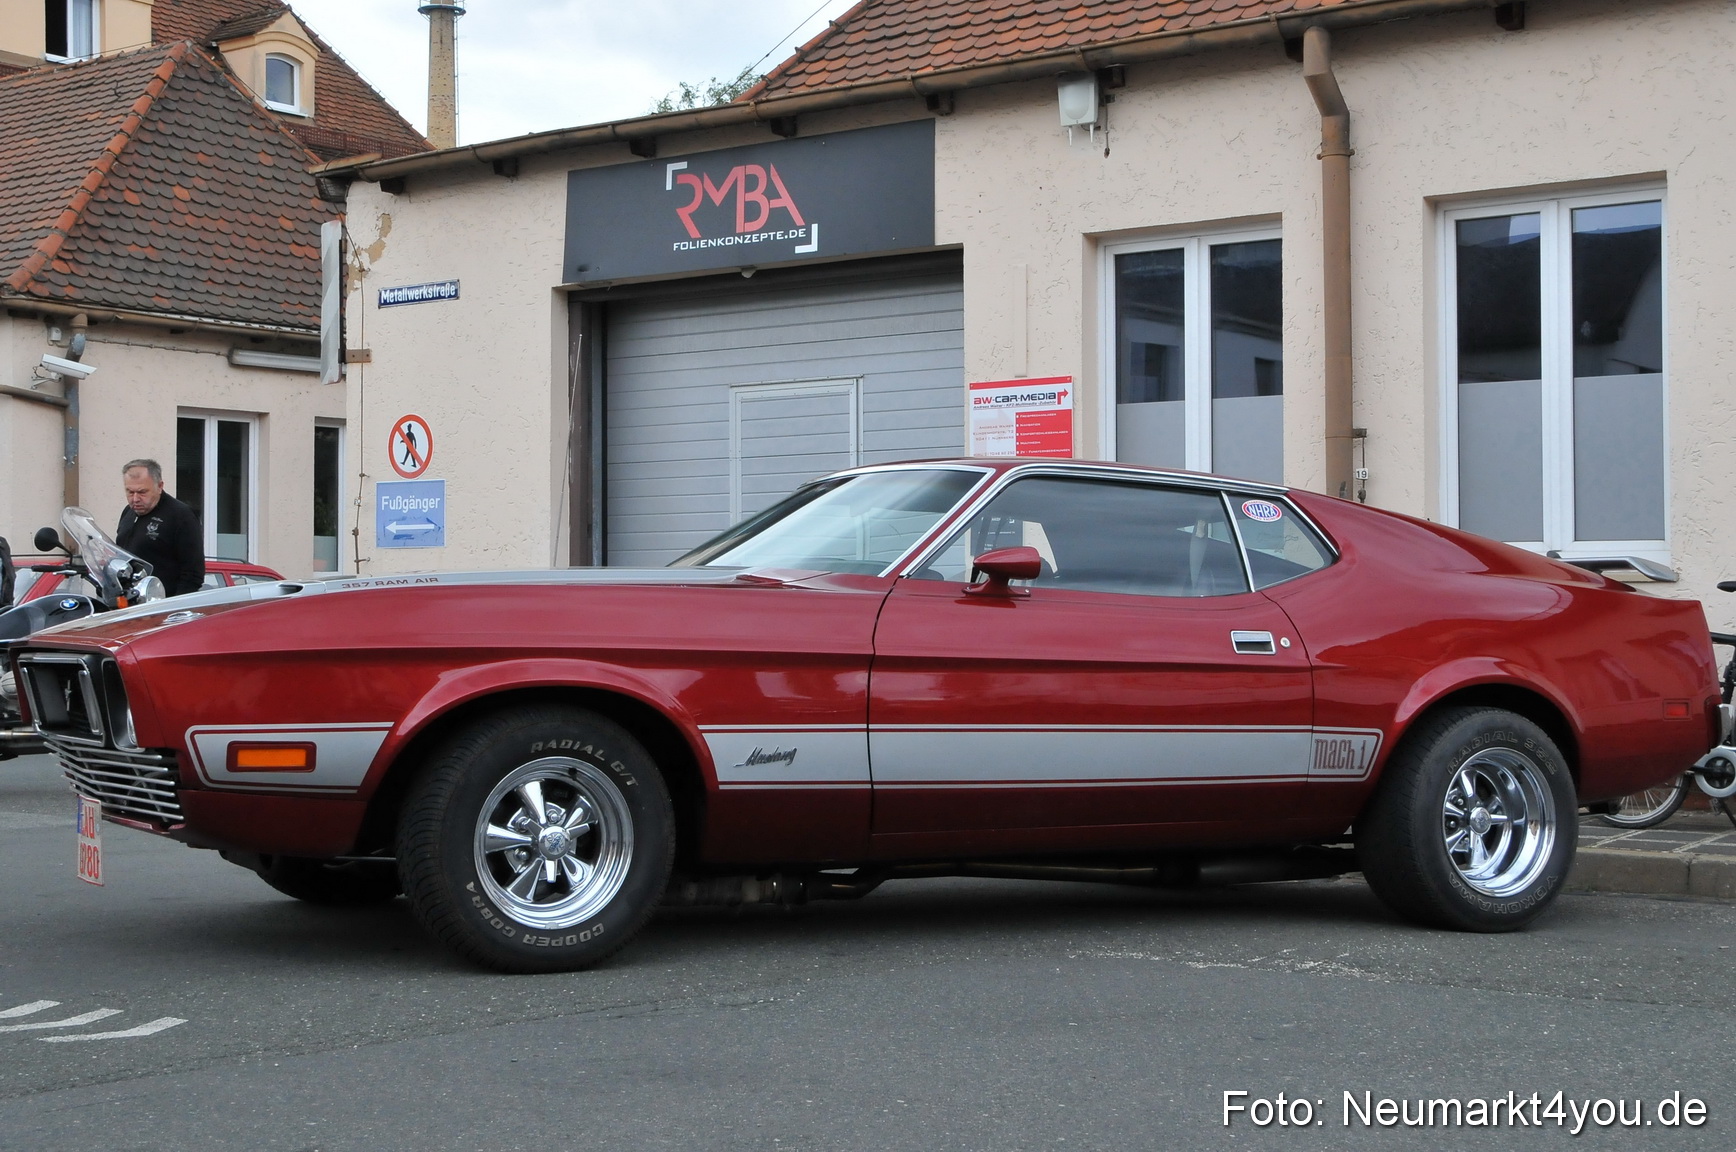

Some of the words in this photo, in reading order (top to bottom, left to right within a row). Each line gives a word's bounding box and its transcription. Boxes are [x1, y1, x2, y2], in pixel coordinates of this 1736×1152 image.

[675, 163, 806, 239] RMBA
[673, 228, 807, 251] FOLIENKONZEPTE.DE
[381, 282, 456, 304] Metallwerkstraße
[1356, 470, 1367, 479] 19
[381, 495, 441, 513] Fußgänger
[1247, 504, 1277, 518] NHRA
[341, 581, 370, 589] 357
[530, 739, 605, 761] RADIAL
[610, 760, 639, 786] G/T
[732, 746, 797, 768] Mustang
[1448, 871, 1558, 914] YOKOHAMA
[466, 881, 517, 938] COBRA
[522, 922, 605, 947] COOPER
